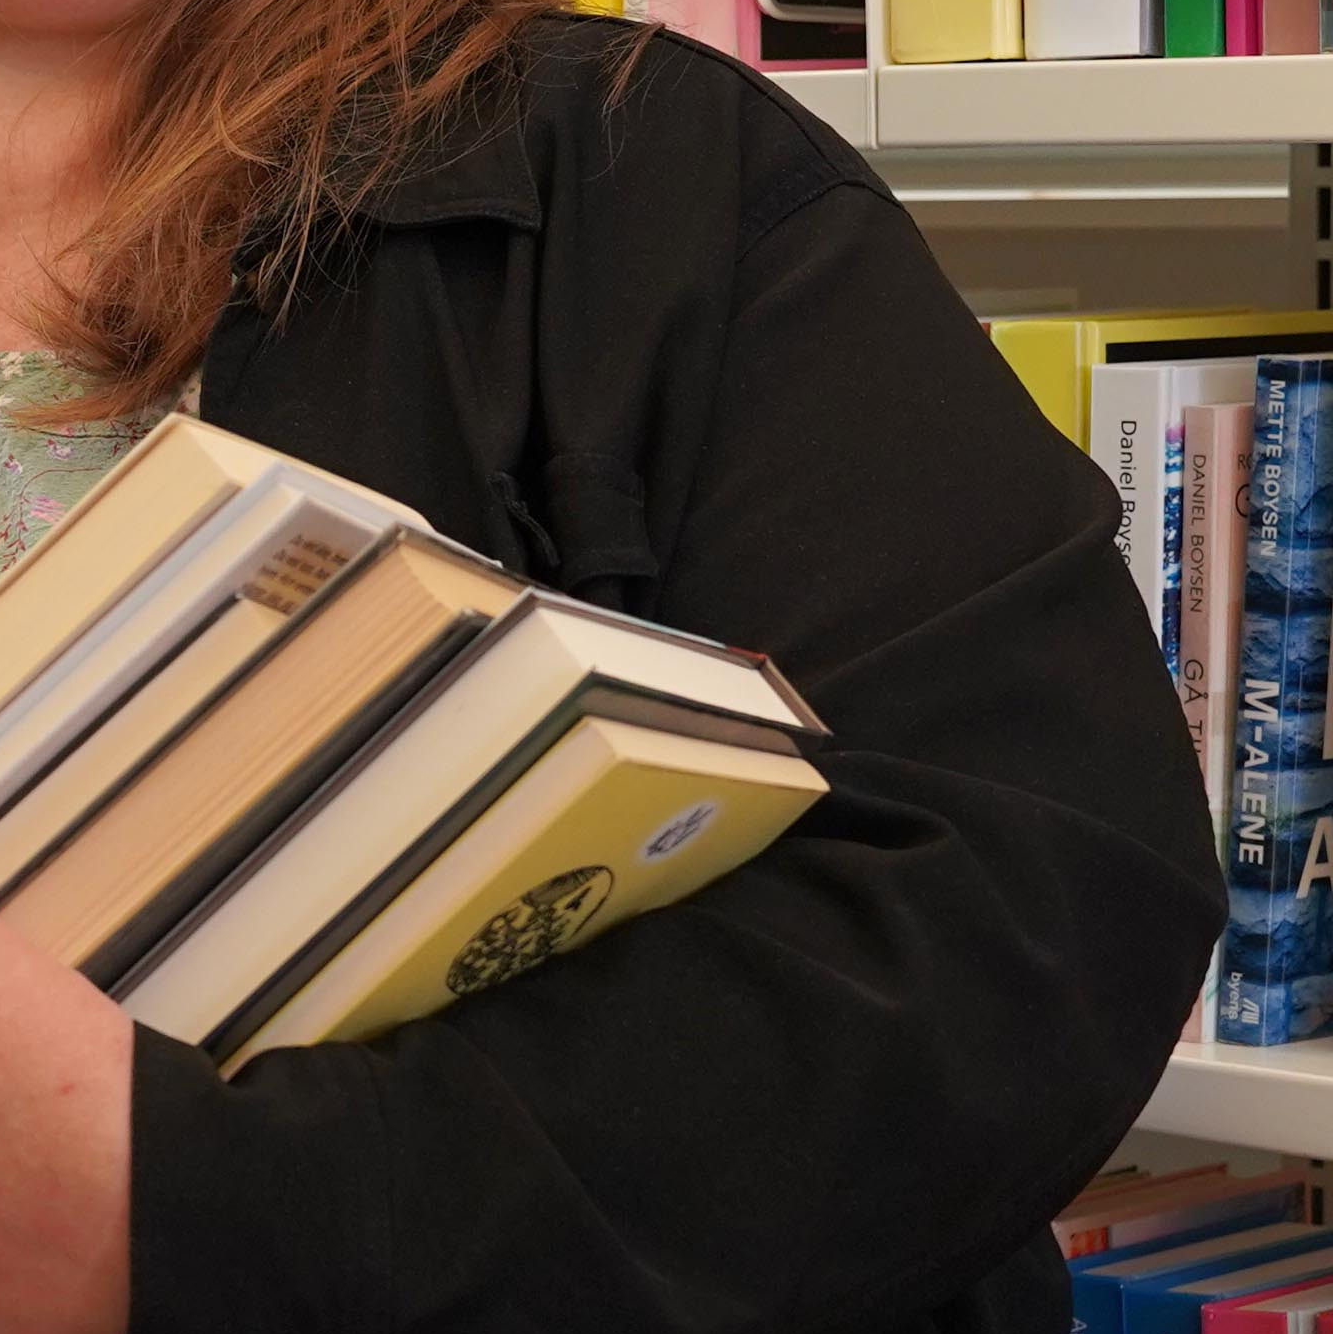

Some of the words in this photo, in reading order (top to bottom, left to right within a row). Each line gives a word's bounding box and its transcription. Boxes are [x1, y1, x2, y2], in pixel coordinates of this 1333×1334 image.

[1119, 420, 1137, 491] Daniel
[1266, 379, 1286, 458] METTE
[1191, 454, 1207, 526] DANIEL
[1260, 464, 1281, 556] BOYSEN
[1190, 535, 1205, 613] BOYSEN
[1184, 659, 1209, 704] GÅ
[1238, 678, 1281, 866] M-ALENE
